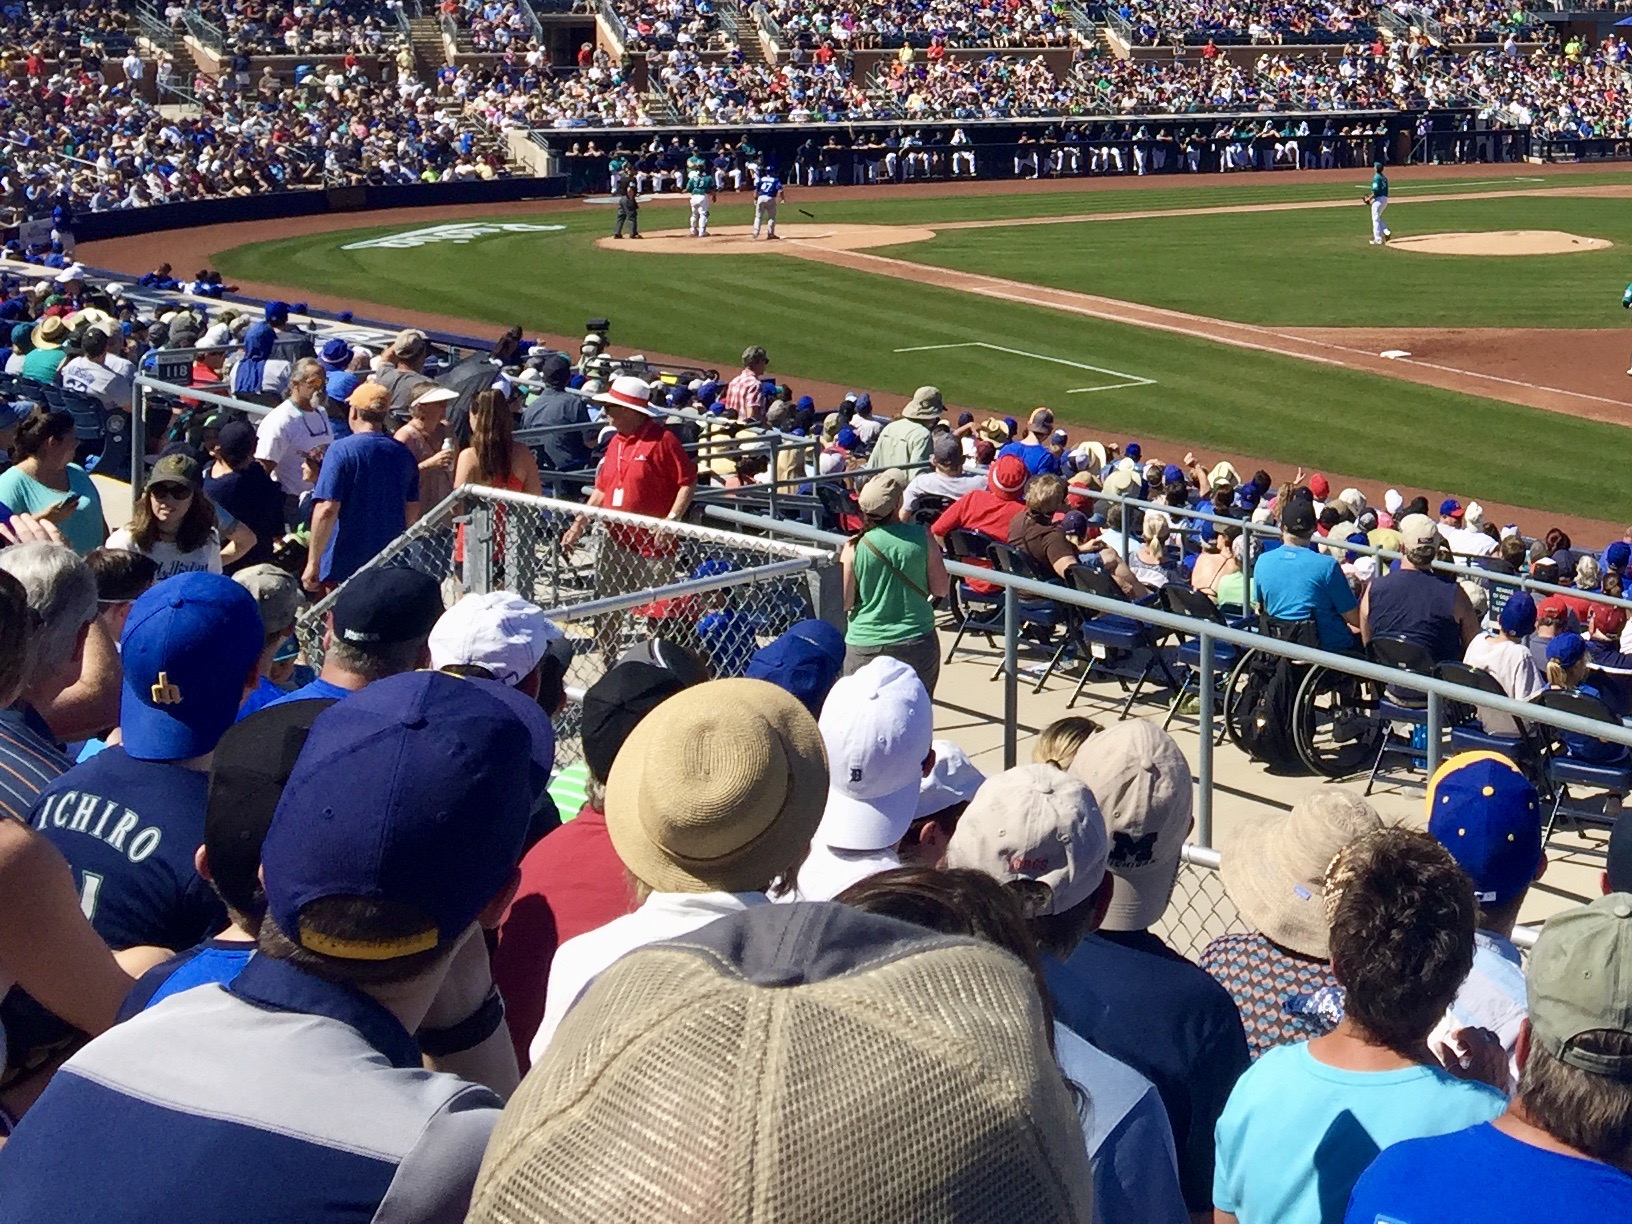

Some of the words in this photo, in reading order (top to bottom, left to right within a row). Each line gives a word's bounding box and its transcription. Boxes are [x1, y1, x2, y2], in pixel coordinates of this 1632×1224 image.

[166, 364, 188, 378] 118
[36, 790, 162, 864] ICHIRO
[1107, 830, 1158, 862] M
